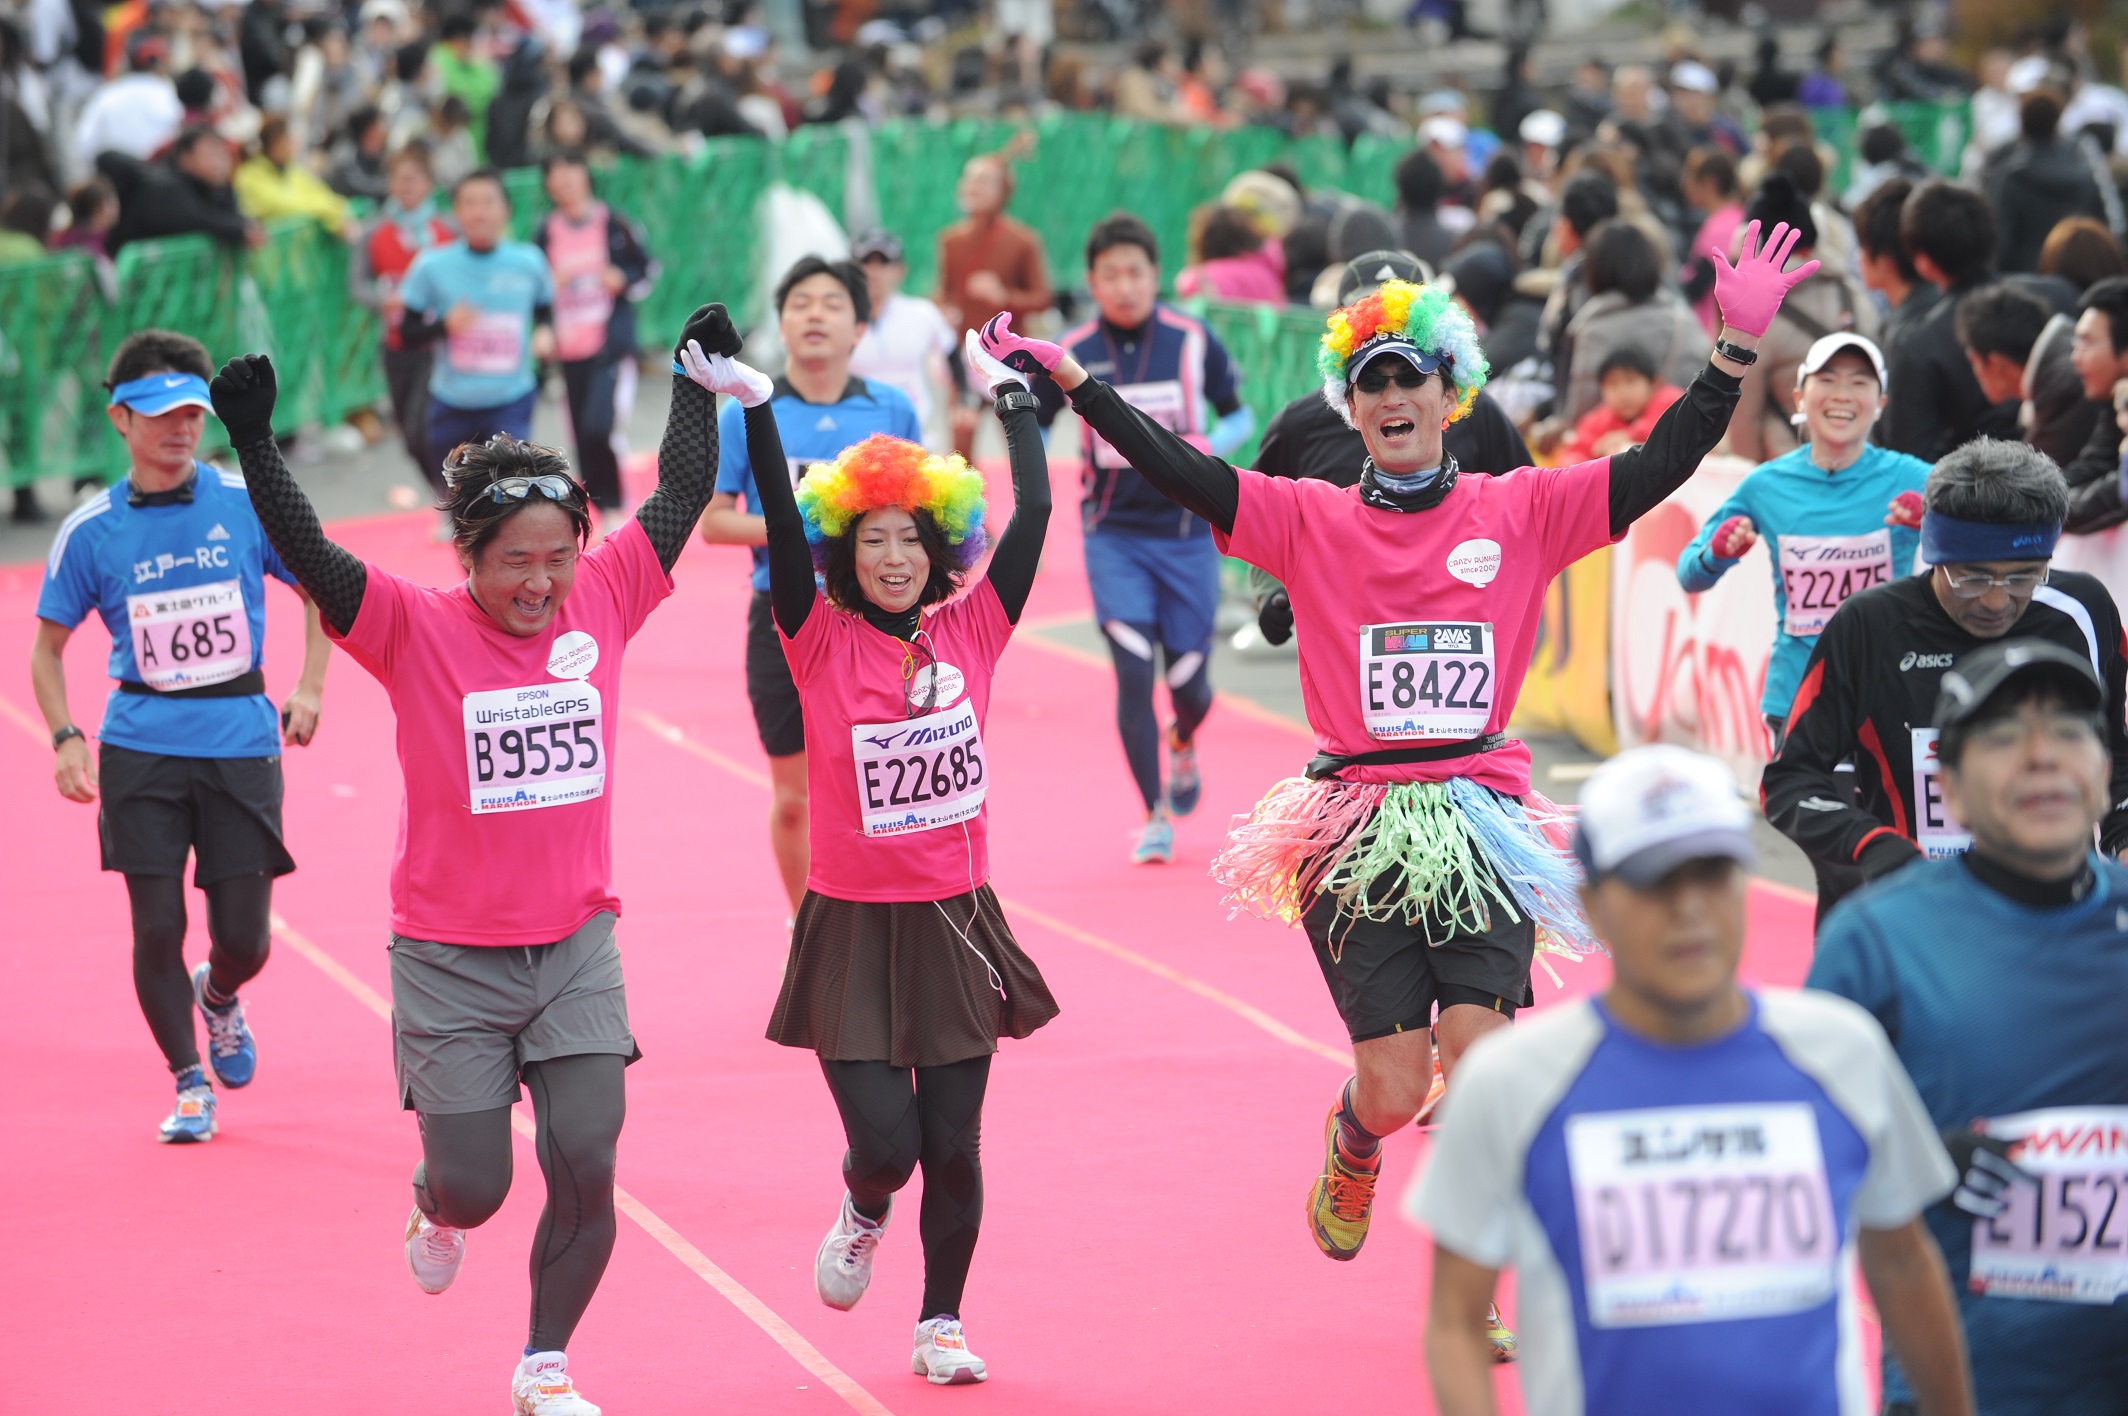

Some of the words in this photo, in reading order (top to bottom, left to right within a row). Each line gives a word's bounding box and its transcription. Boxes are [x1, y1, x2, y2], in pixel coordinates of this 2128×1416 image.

[1474, 553, 1501, 564] RUNNER
[1385, 628, 1428, 637] SUPER
[143, 627, 159, 668] A
[170, 613, 237, 662] 685
[1384, 634, 1428, 649] VAAM
[935, 671, 962, 685] UNNERS
[1368, 659, 1491, 711] E8422
[517, 689, 550, 702] EPSON
[476, 698, 590, 724] WristableGPS
[1374, 730, 1425, 738] MARATHON
[474, 718, 599, 783] B9555
[863, 736, 983, 810] E22685
[481, 800, 537, 810] MARATHON
[873, 822, 927, 835] MARATHON
[1597, 1173, 1820, 1271] D17270
